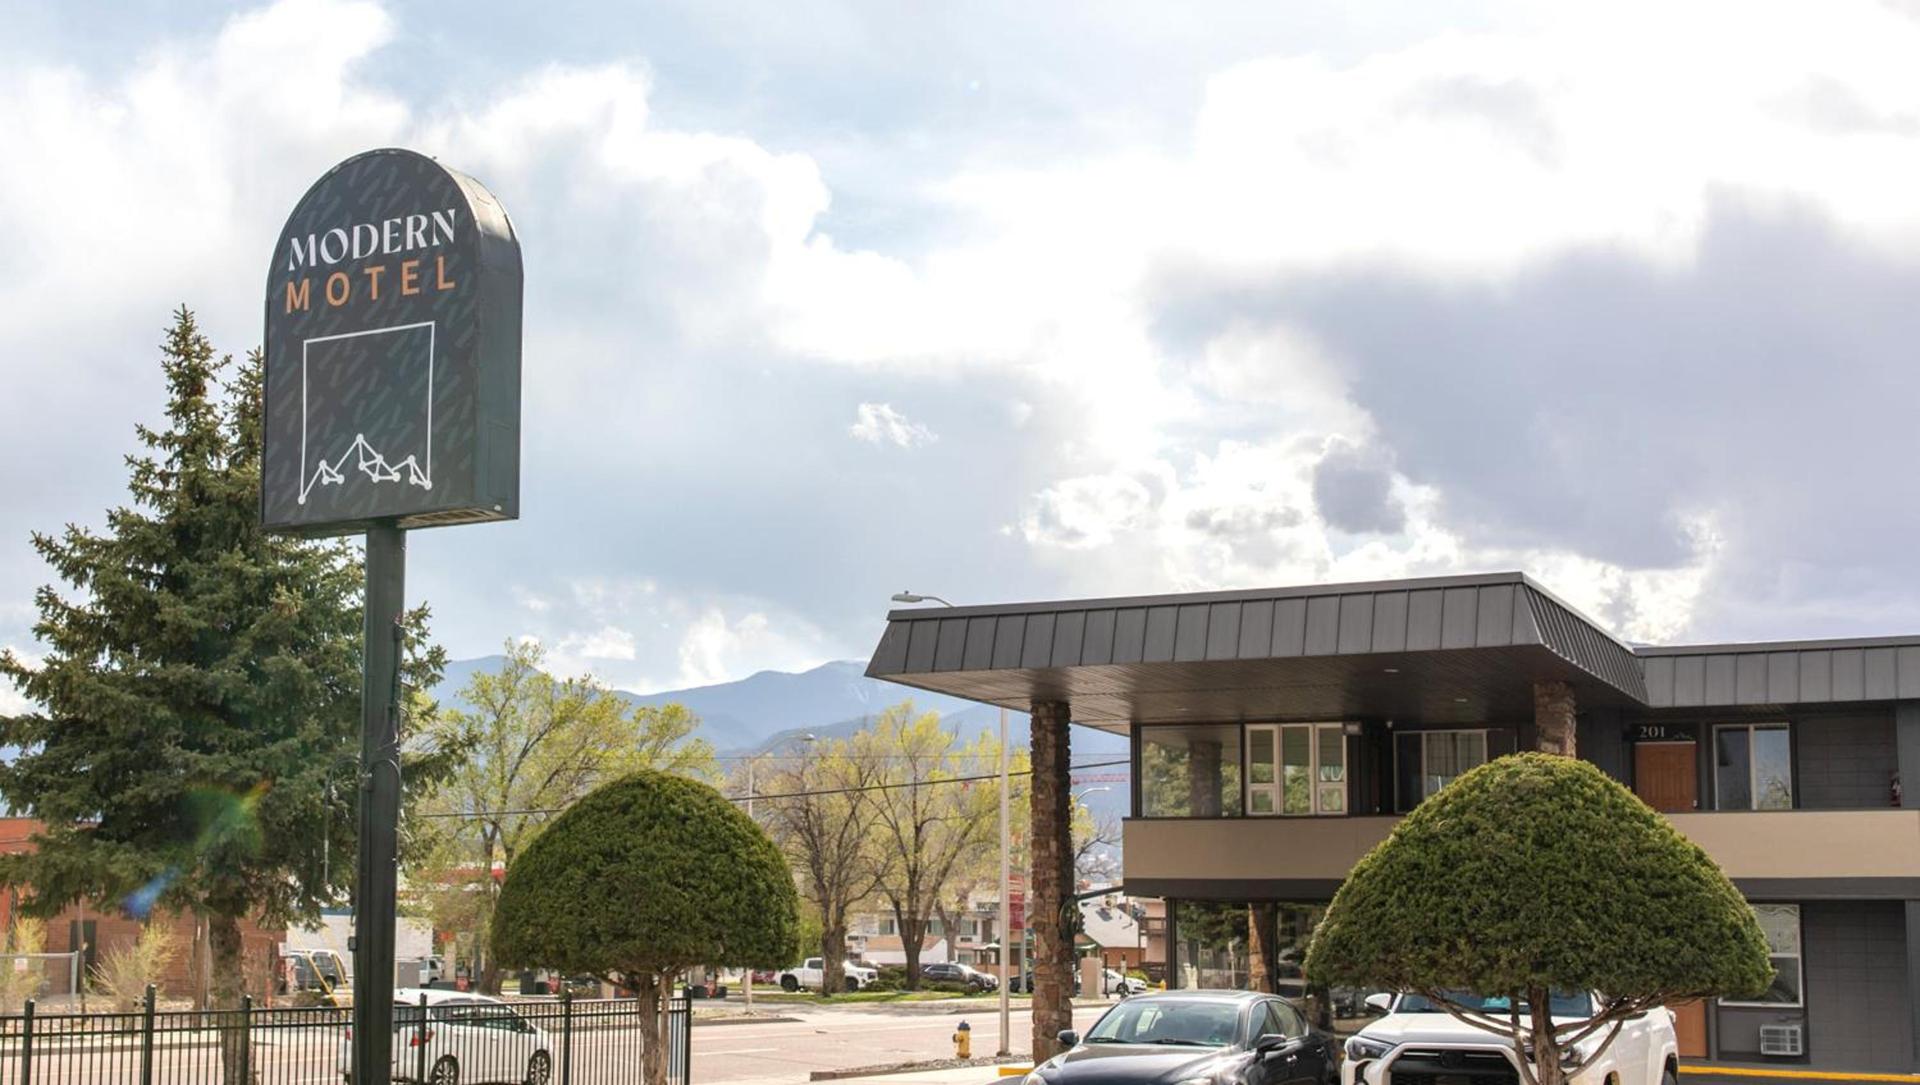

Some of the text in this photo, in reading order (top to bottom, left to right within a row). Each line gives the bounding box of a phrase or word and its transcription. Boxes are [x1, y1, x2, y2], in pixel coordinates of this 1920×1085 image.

[288, 209, 456, 271] MODERN
[285, 256, 455, 314] MOTEL
[1640, 726, 1665, 738] 201
